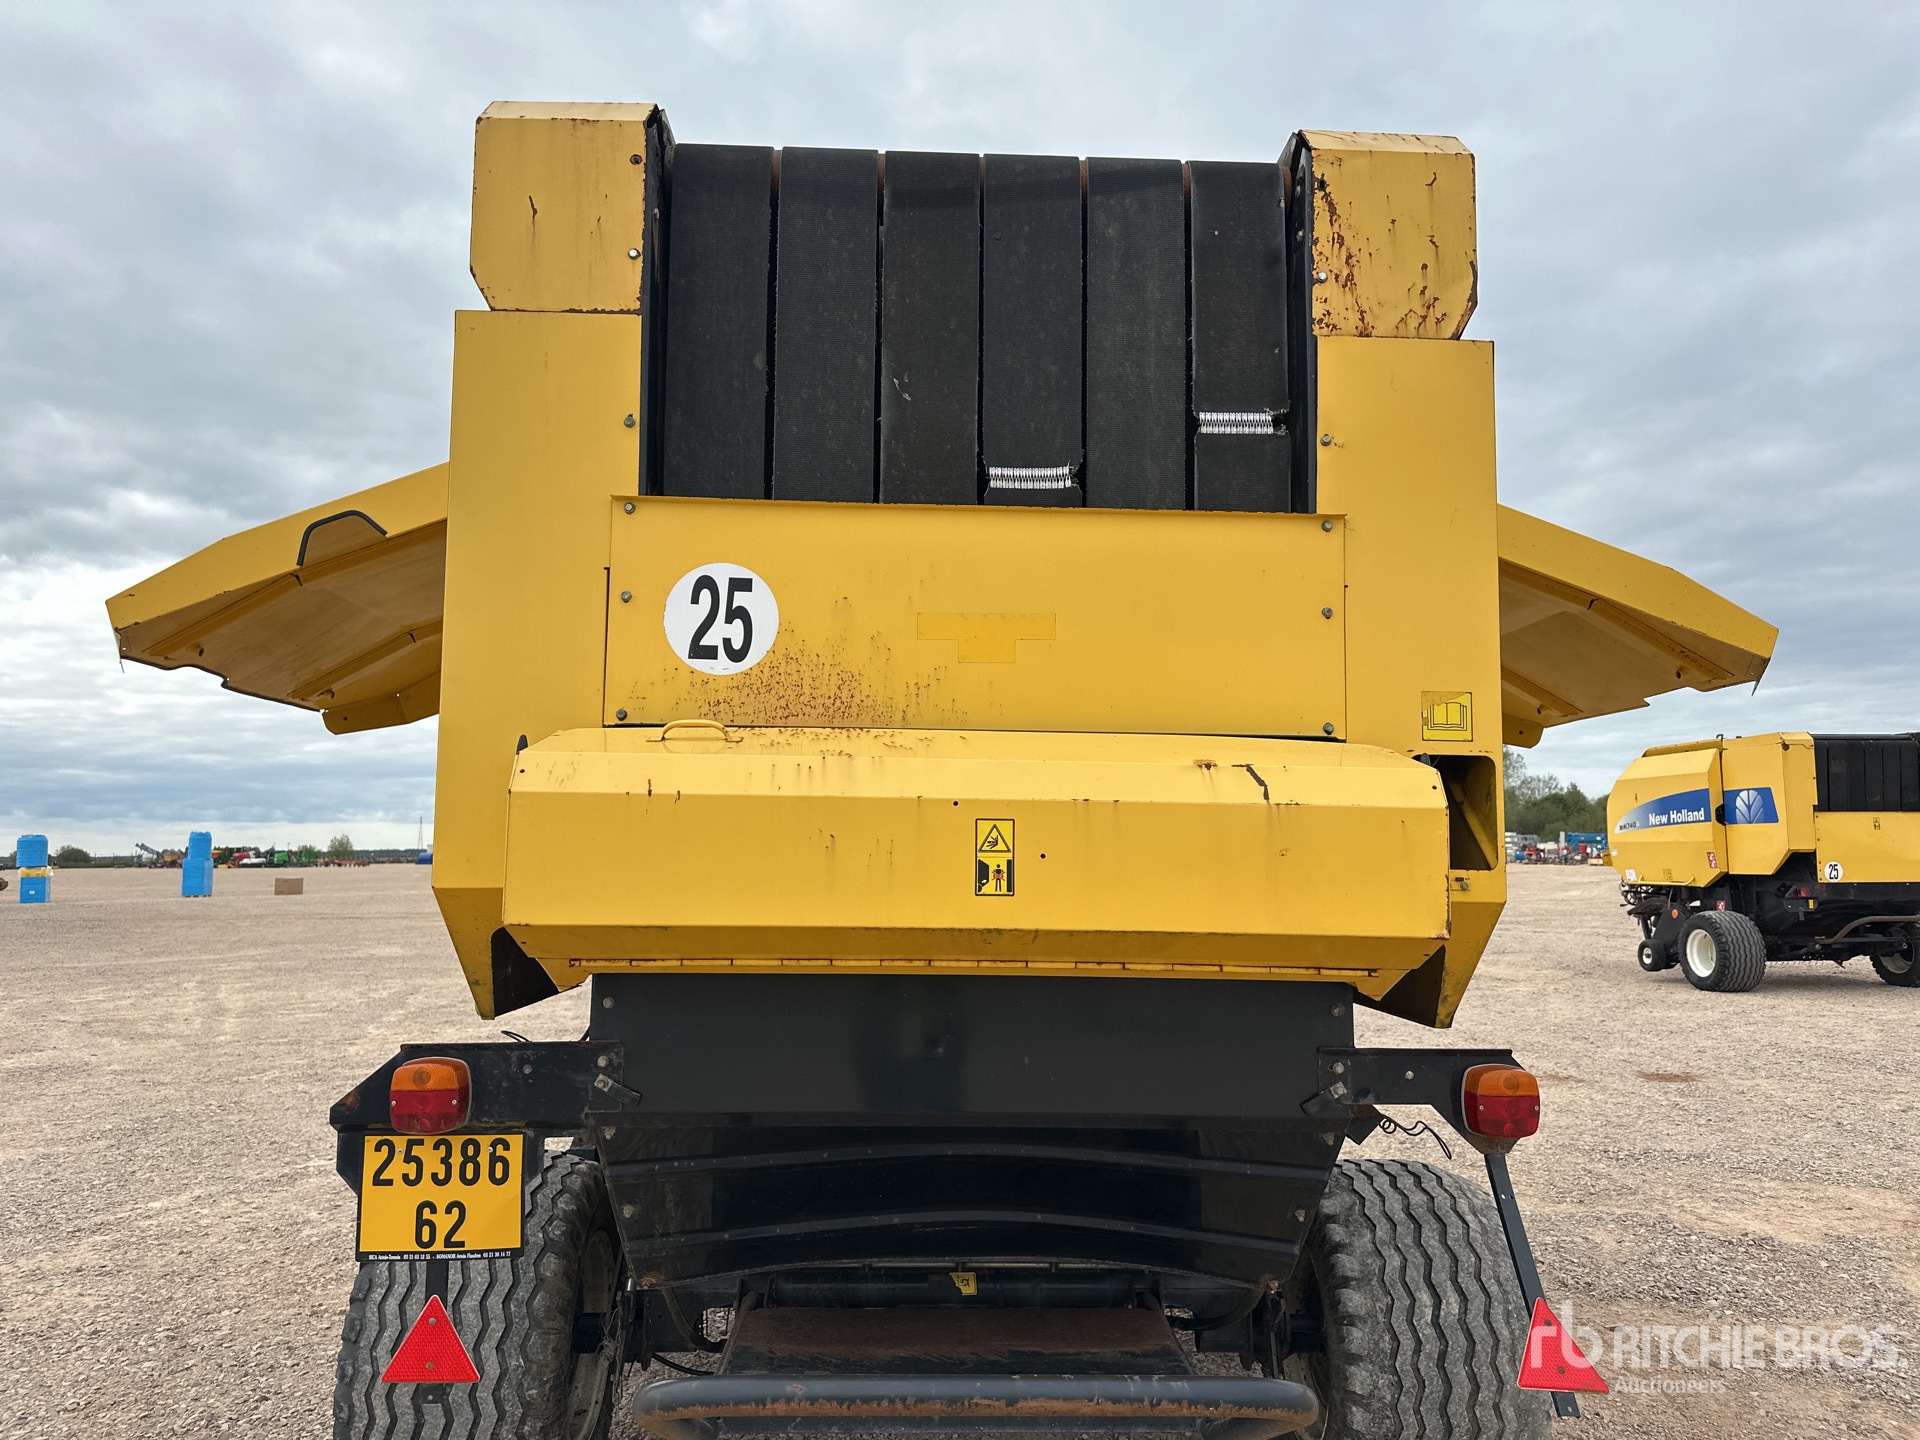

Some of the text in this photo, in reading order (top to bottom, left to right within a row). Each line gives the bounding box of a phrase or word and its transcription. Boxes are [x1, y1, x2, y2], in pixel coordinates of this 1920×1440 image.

[687, 574, 754, 664] 25
[1648, 807, 1705, 826] New Holland
[1828, 863, 1839, 880] 25
[372, 1137, 511, 1187] 25386
[414, 1199, 467, 1250] 62
